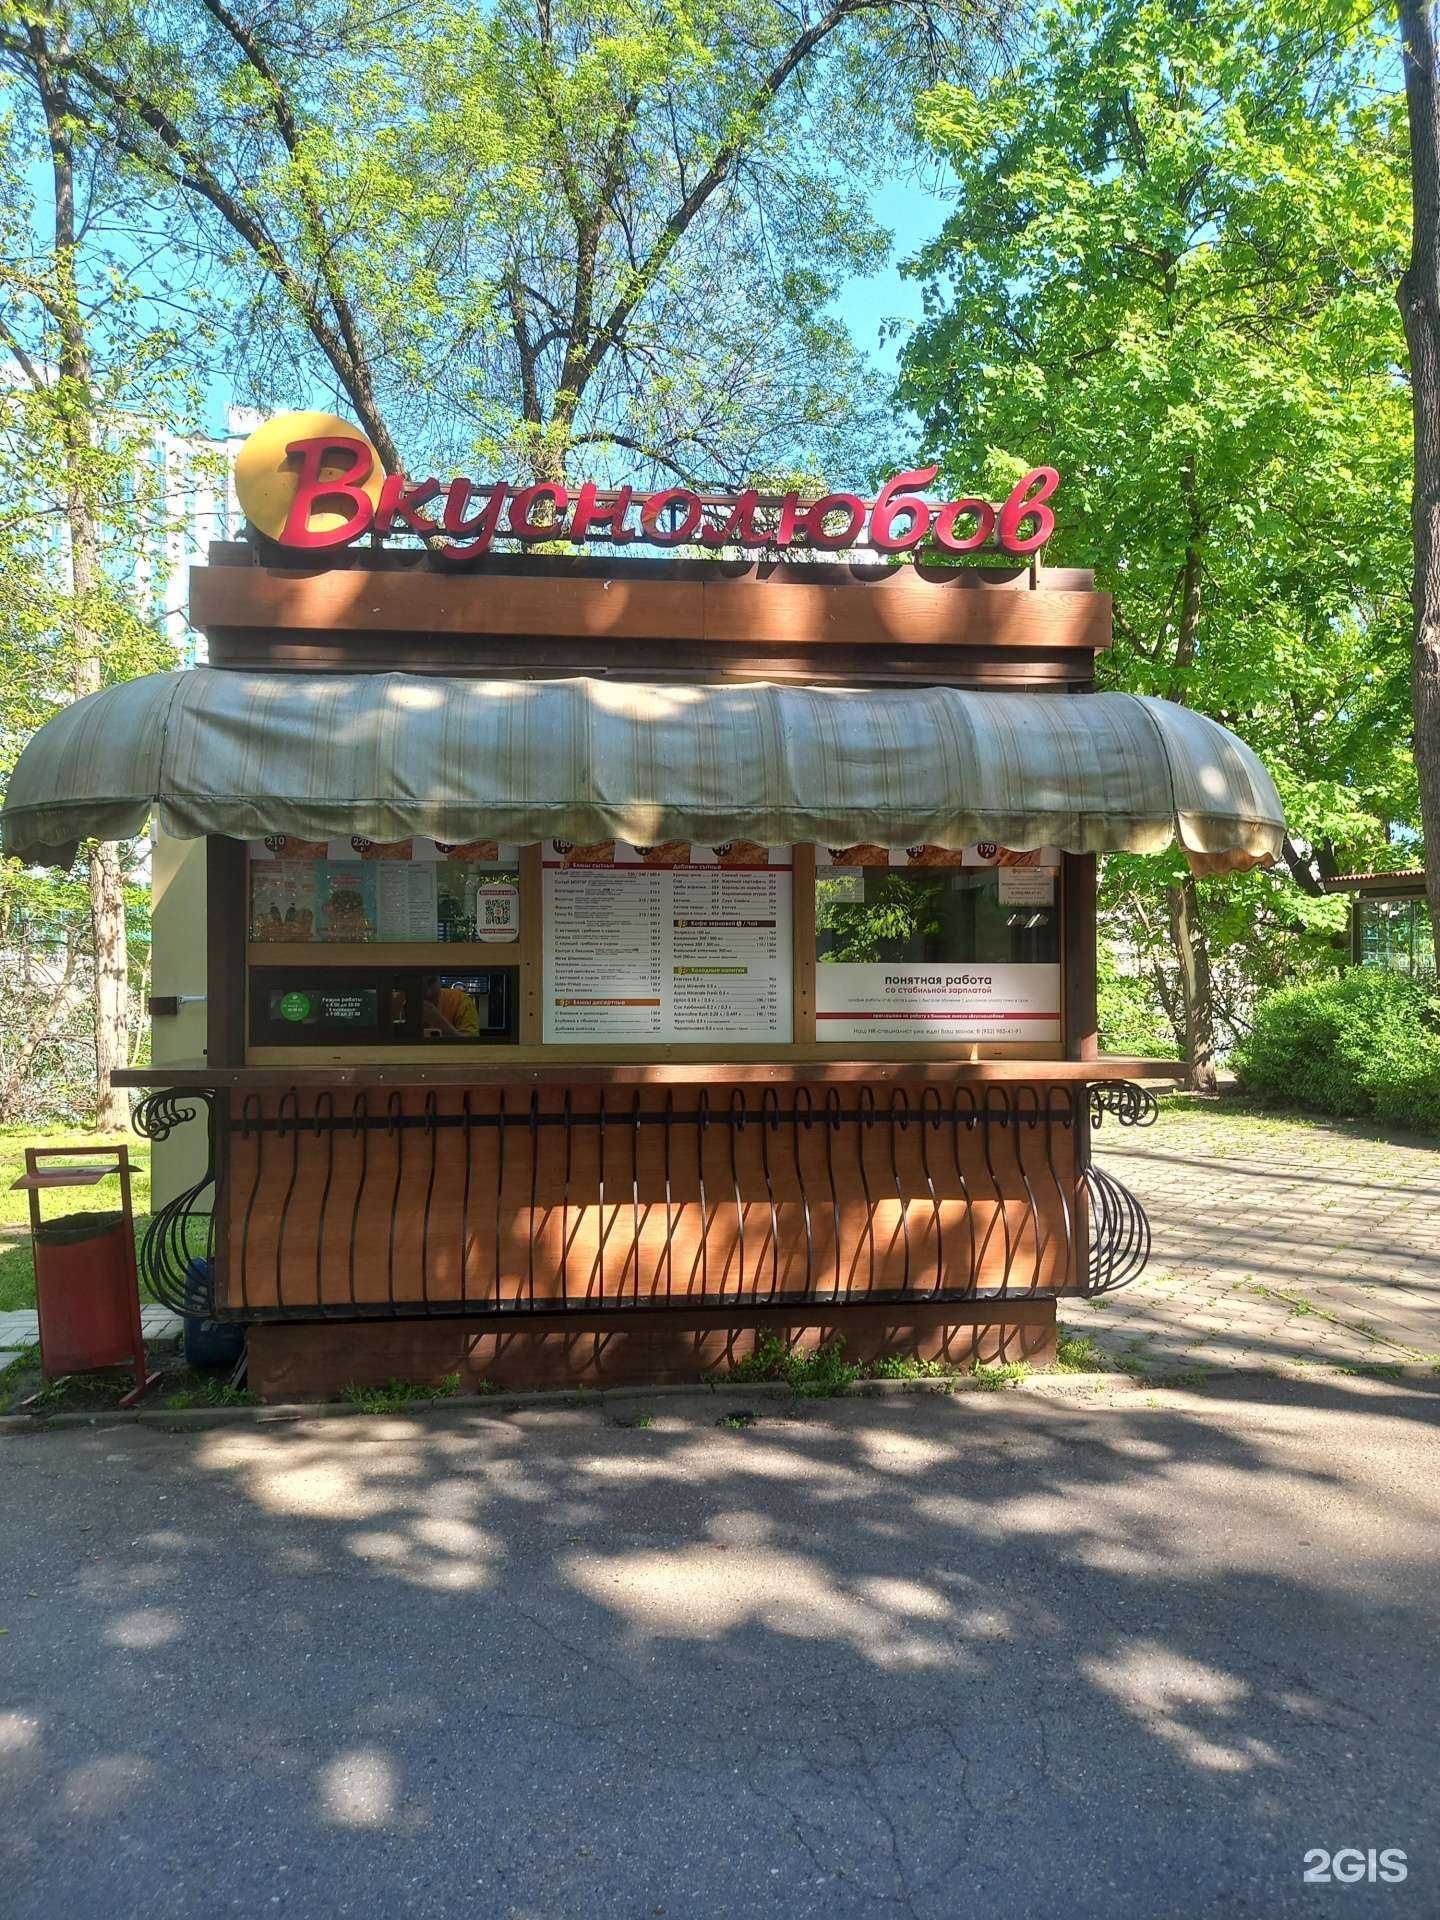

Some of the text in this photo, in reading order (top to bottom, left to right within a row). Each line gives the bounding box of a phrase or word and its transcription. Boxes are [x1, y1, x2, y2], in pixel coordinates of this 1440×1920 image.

[282, 436, 1059, 560] Вкуснолюбов
[980, 844, 995, 853] 170
[885, 974, 992, 987] понятная работа
[898, 986, 946, 994] стабильной
[948, 986, 992, 995] зарплатой
